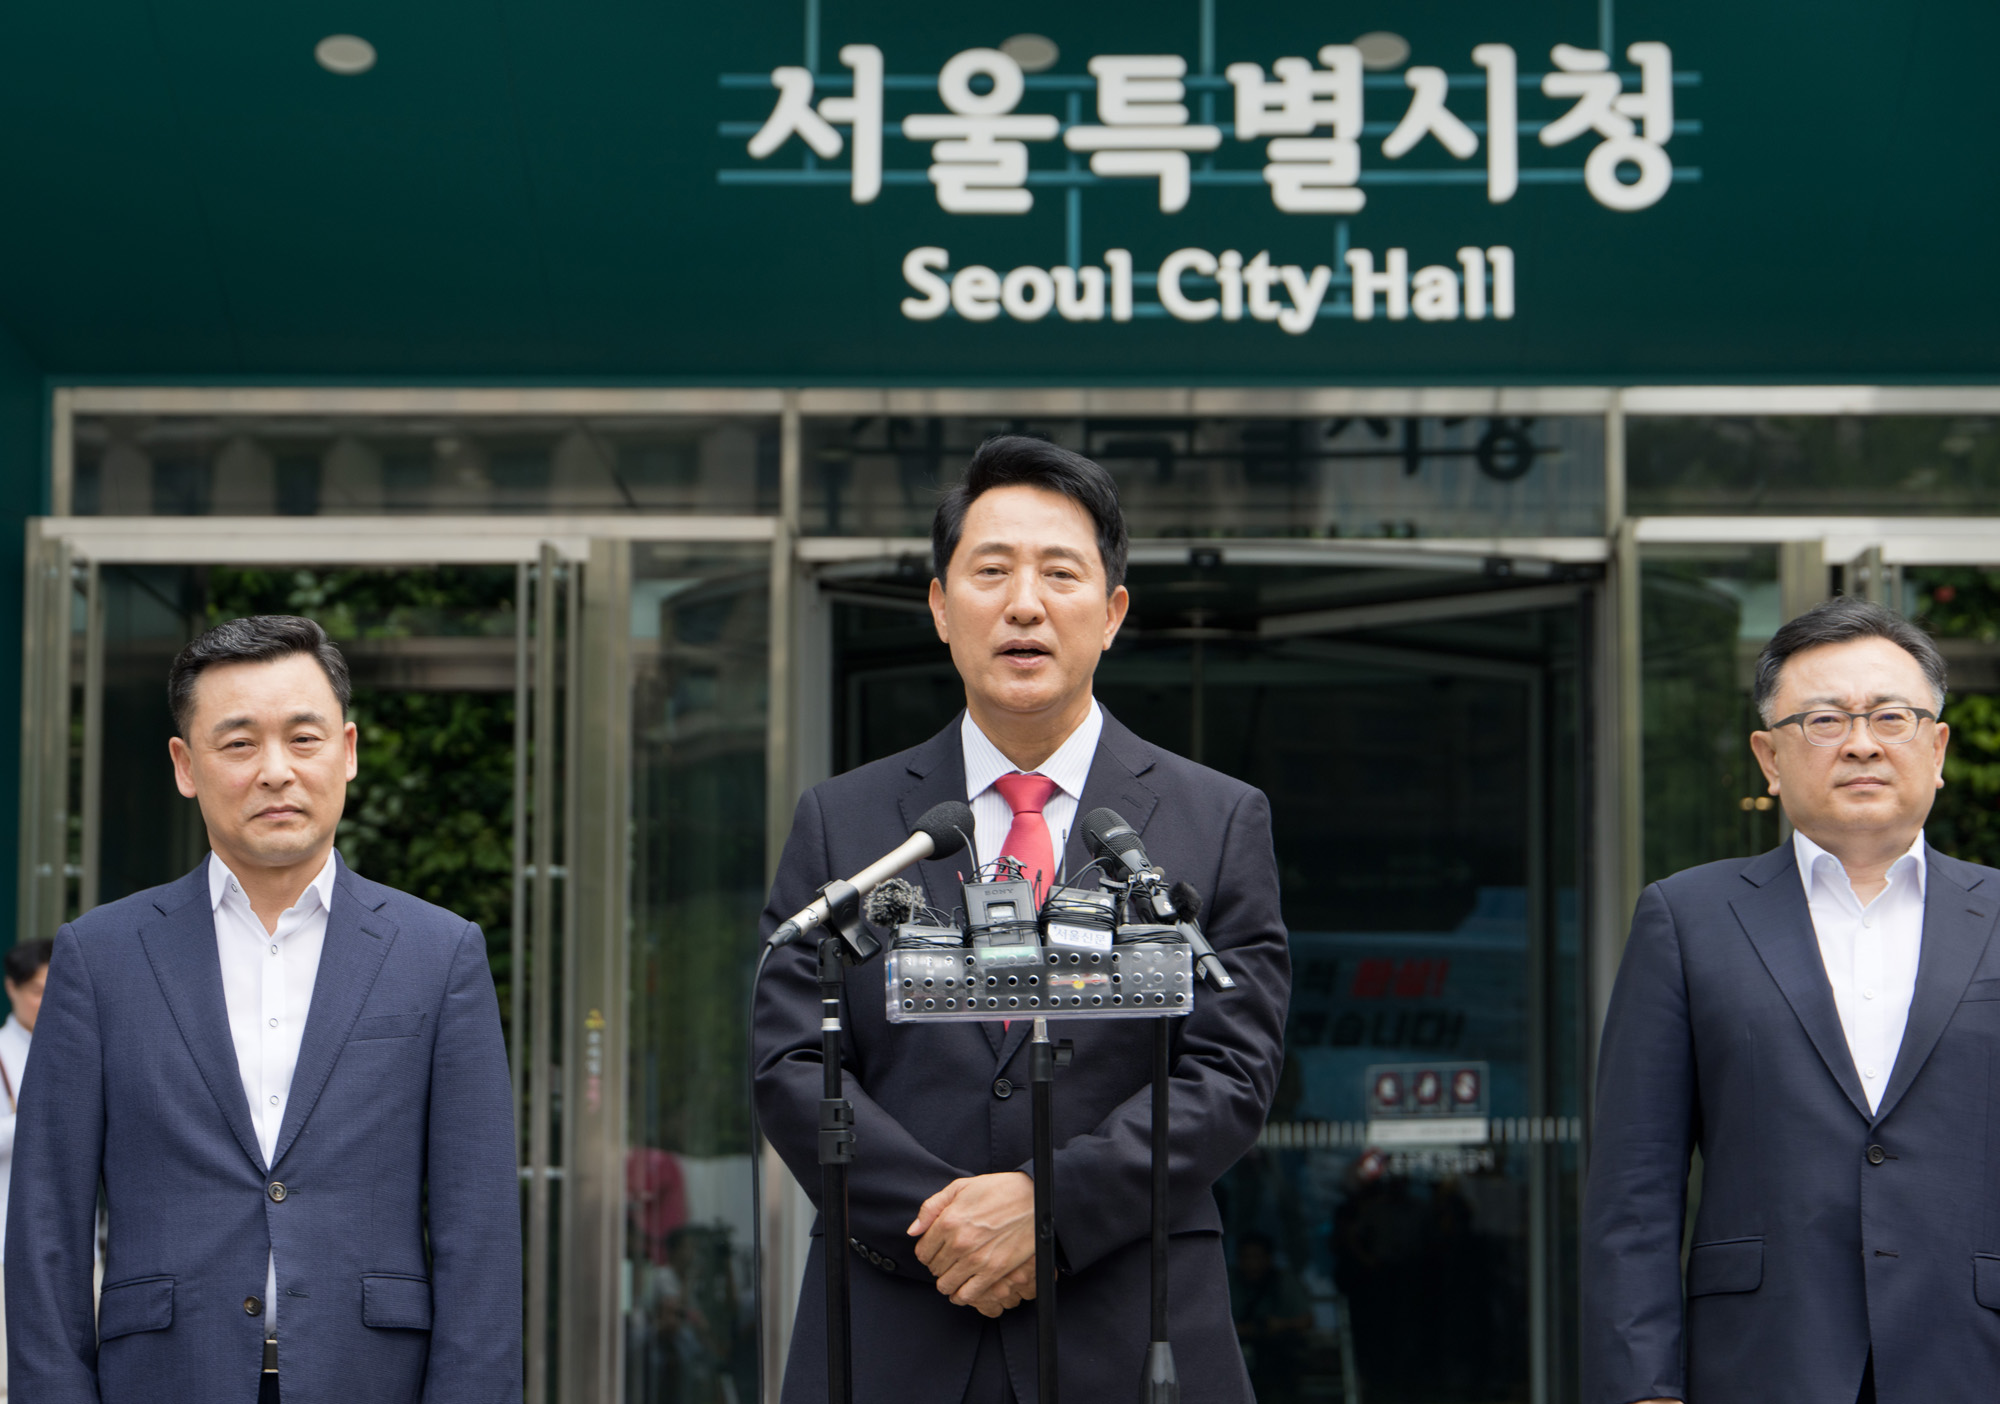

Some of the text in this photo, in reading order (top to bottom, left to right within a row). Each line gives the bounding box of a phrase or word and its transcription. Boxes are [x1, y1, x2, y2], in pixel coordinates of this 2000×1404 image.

[747, 42, 1674, 213] 서울특별시청
[902, 247, 1515, 334] Seoul City Hall
[984, 888, 1014, 896] SONY
[1056, 928, 1106, 947] 서울신문
